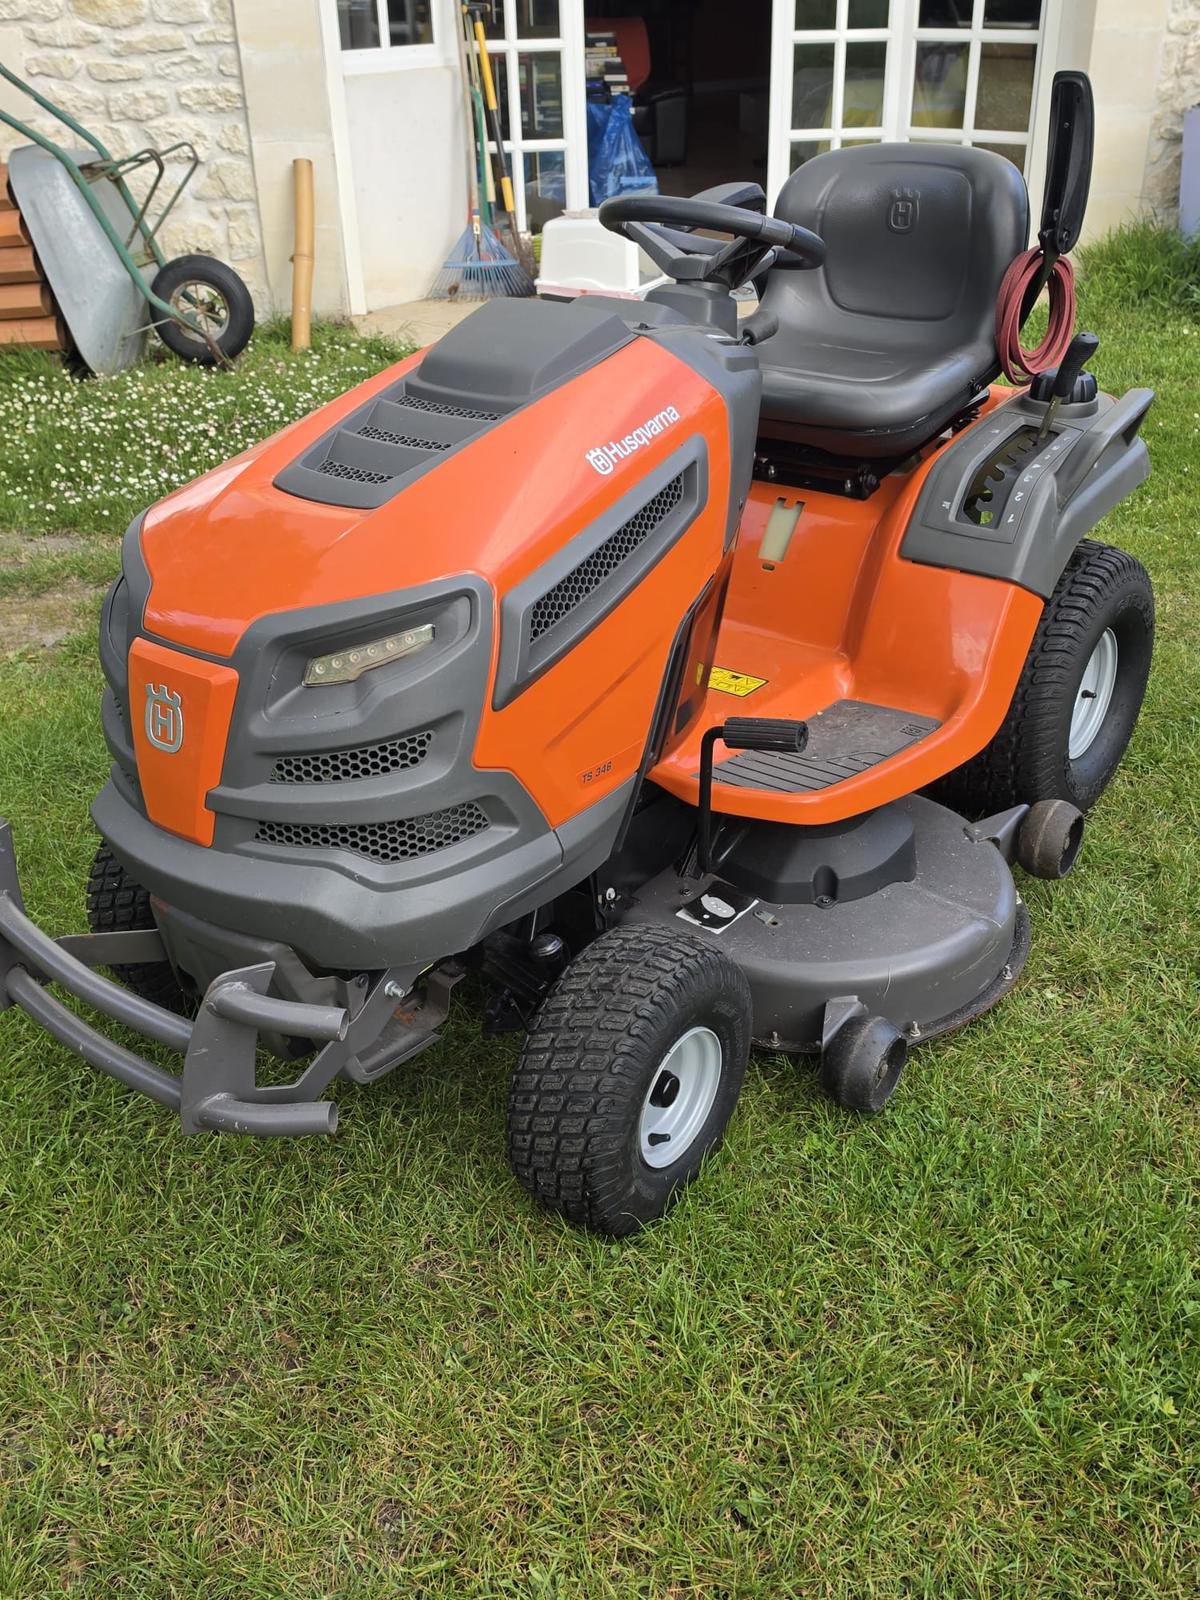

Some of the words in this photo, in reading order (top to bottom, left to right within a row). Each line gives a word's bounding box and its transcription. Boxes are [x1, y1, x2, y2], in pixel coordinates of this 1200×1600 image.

[603, 406, 680, 463] Husqvarna
[1014, 492, 1024, 502] 2
[1007, 514, 1014, 523] 1
[582, 771, 593, 784] TS
